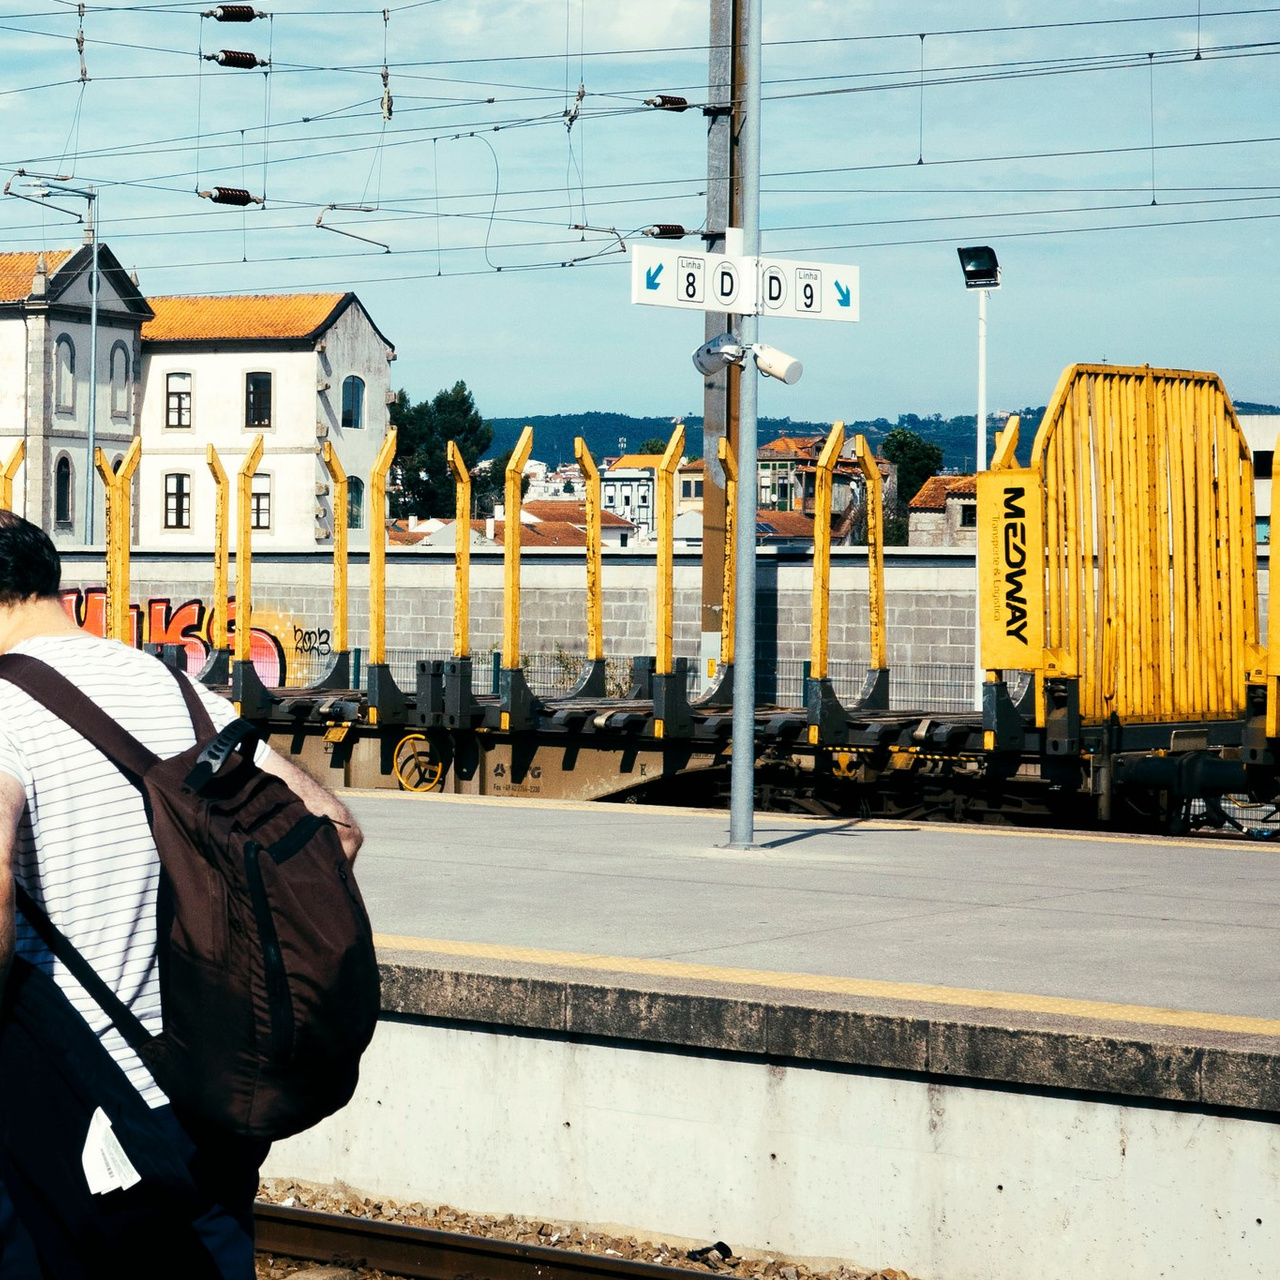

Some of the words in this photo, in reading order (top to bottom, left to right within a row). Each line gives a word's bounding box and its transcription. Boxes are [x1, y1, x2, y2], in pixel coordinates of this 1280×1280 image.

[681, 259, 701, 270] Linha
[798, 270, 818, 281] Linha
[685, 272, 696, 299] 8
[720, 271, 734, 297] D
[768, 275, 781, 301] D
[803, 283, 814, 309] 9
[1003, 487, 1029, 646] MEDWAY
[293, 624, 331, 658] 2023
